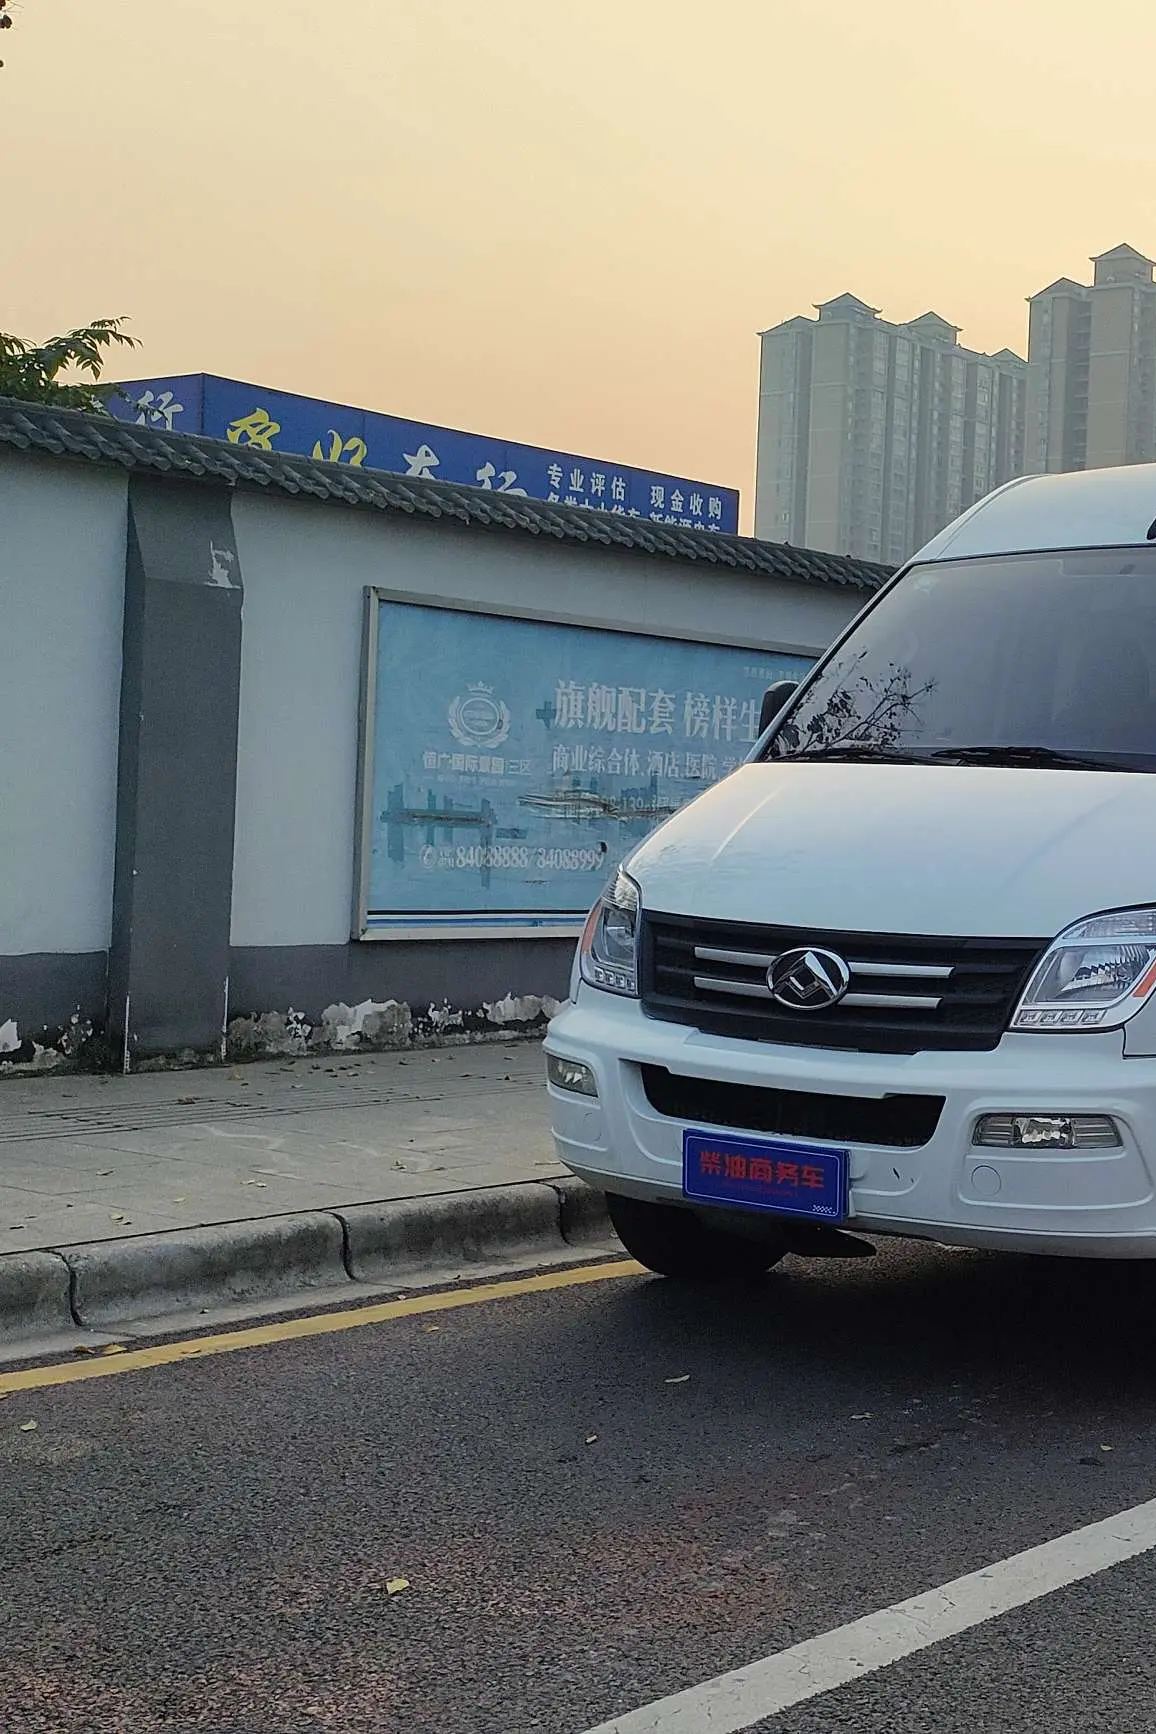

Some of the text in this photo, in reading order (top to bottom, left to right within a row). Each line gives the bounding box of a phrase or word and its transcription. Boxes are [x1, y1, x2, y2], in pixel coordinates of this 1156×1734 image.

[547, 463, 627, 502] 专业评估
[650, 485, 722, 520] 现金收购
[554, 679, 676, 735] 旗舰配套
[683, 691, 761, 743] 榜样生
[699, 1150, 825, 1189] 柴油商务车
